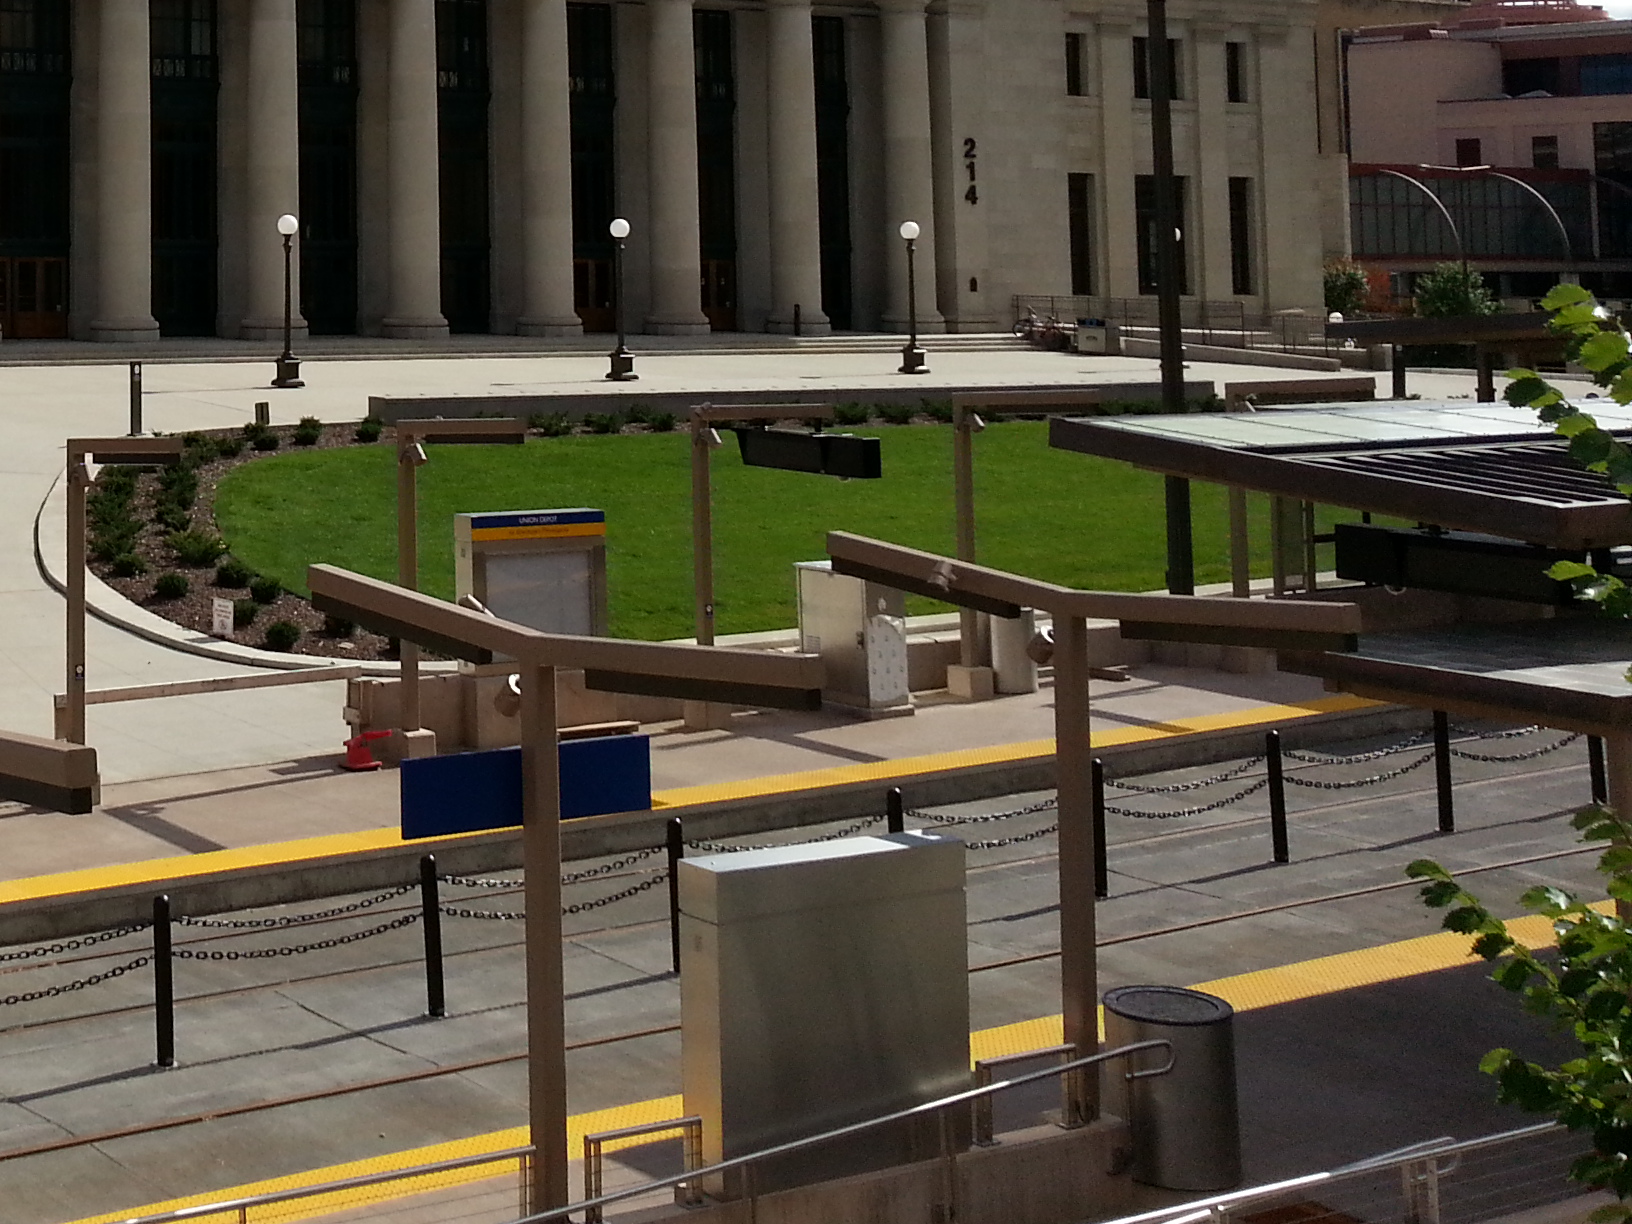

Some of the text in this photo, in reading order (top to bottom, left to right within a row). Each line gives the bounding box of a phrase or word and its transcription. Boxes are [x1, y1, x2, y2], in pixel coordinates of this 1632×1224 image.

[963, 137, 978, 205] 214
[518, 515, 557, 524] UNION DEPOT
